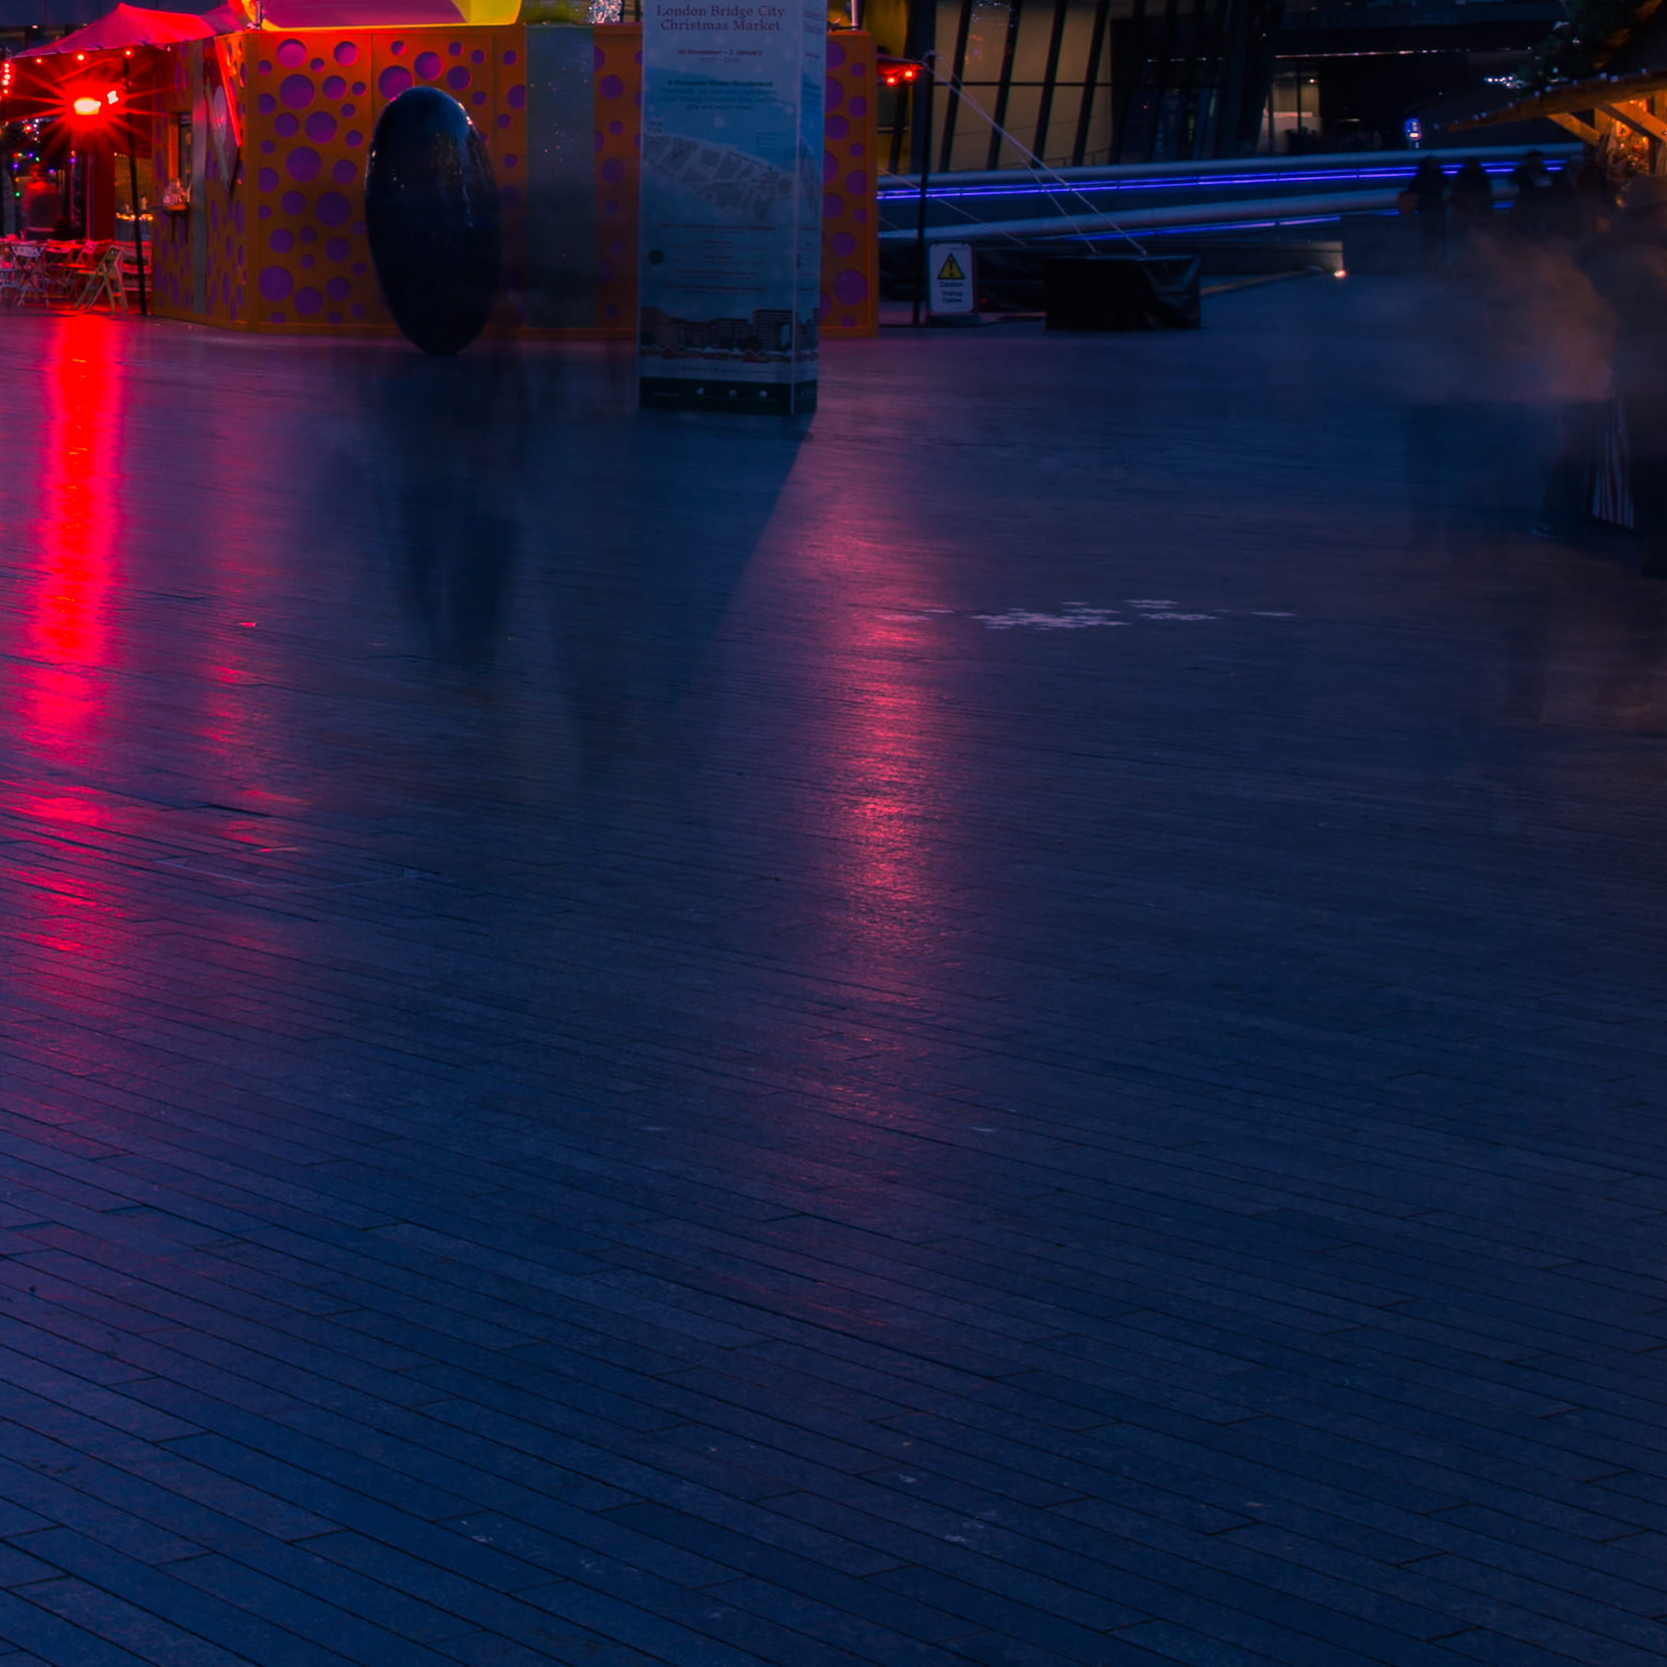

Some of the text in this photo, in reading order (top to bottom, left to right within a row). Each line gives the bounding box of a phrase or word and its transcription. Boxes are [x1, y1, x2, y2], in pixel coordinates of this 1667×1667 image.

[657, 5, 785, 19] London Bridge City
[660, 19, 782, 31] Christmas Market
